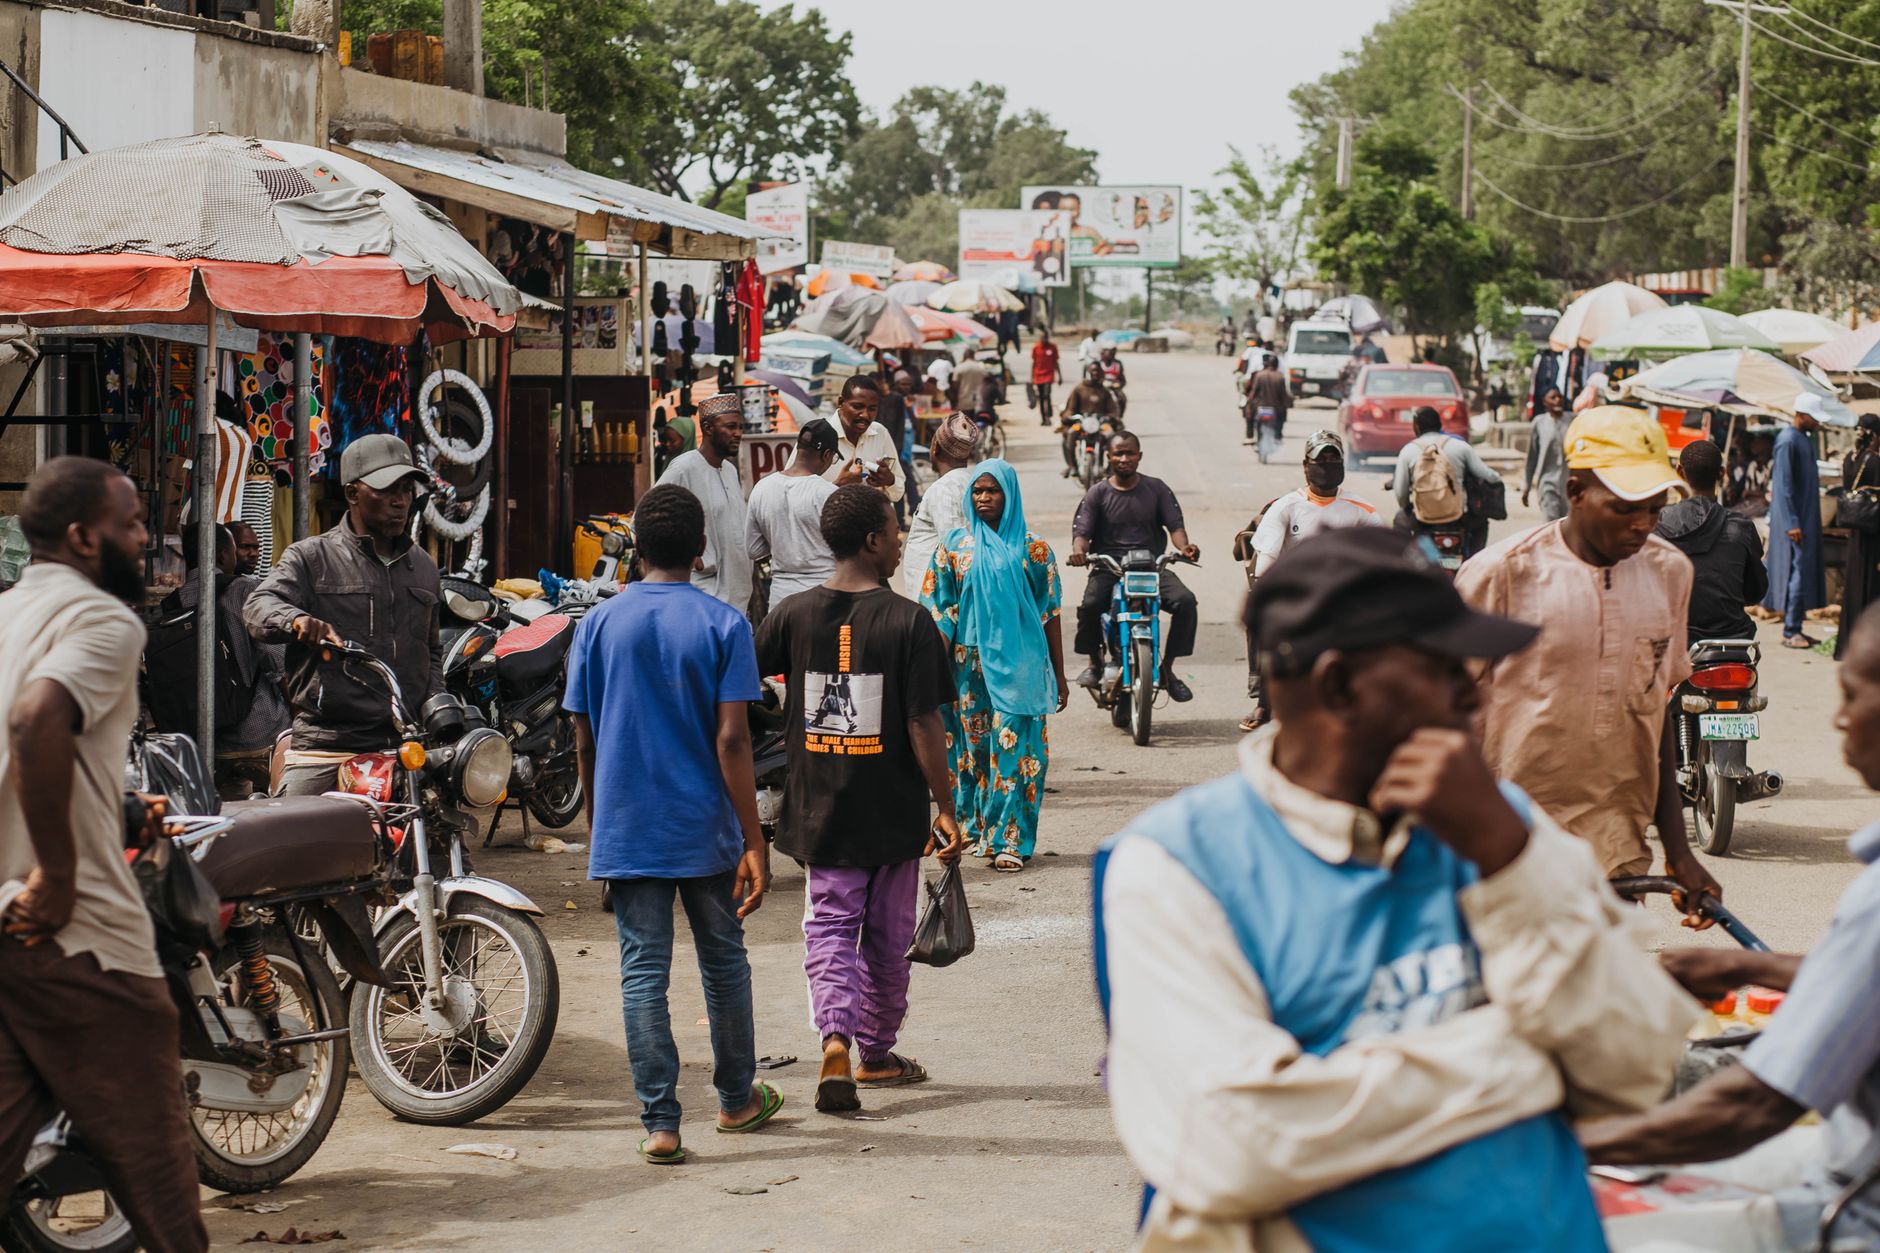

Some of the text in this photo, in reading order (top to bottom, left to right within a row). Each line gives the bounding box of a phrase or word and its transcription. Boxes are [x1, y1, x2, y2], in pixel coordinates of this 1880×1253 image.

[839, 624, 852, 673] INCLUSIVE
[806, 734, 880, 746] THE MALE SEAHORSE
[832, 745, 845, 754] THE
[847, 744, 884, 755] CHILDREN
